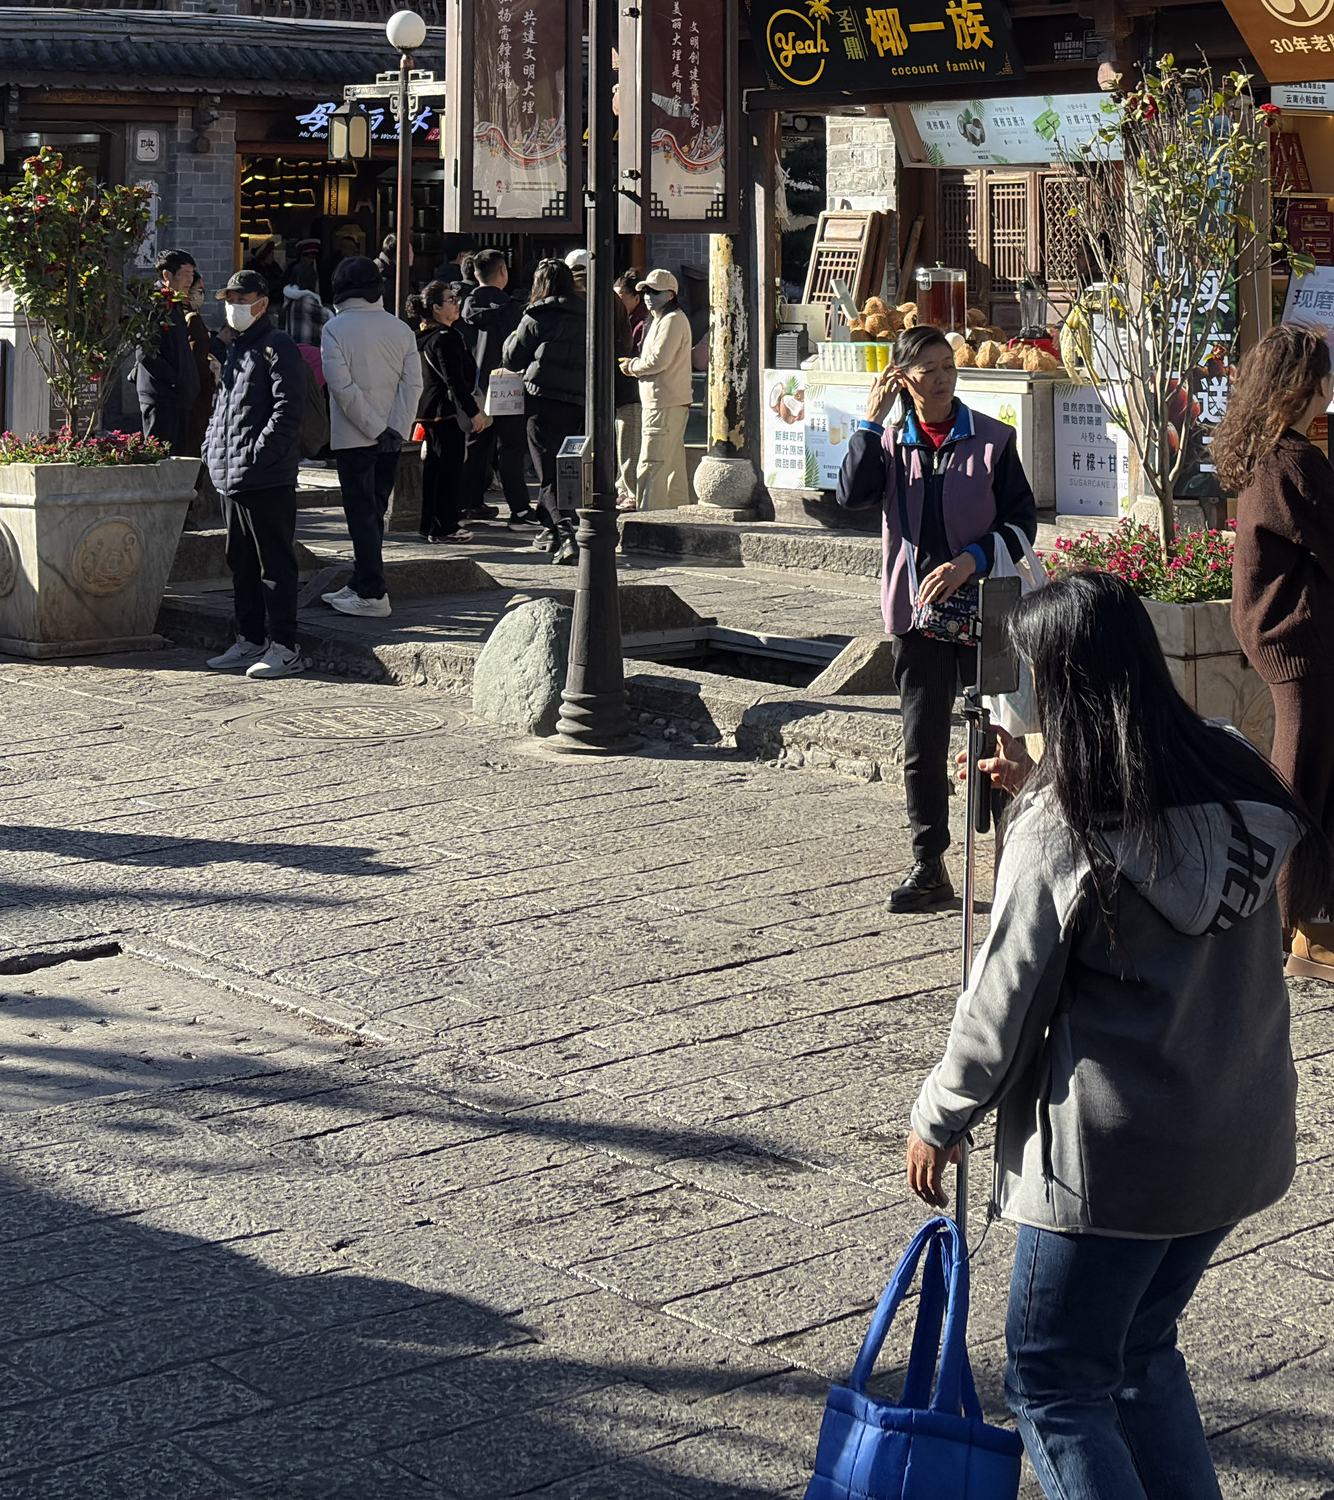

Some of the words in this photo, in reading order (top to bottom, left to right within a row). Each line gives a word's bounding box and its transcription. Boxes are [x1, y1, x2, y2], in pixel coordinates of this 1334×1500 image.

[835, 9, 863, 61] 圣鼎
[773, 20, 831, 68] Yeah
[521, 9, 538, 115] 共建文明大理
[891, 62, 940, 77] cocount
[946, 58, 986, 74] family
[1286, 94, 1326, 106] 云南小粒咖啡
[140, 137, 155, 153] 映
[1063, 402, 1102, 414] 自然的馈赠
[1063, 414, 1102, 426] 原始的味道
[774, 430, 804, 442] 新鲜现榨
[774, 444, 804, 456] 原汁原味
[1069, 478, 1110, 489] SUGARCANE
[1112, 481, 1128, 490] JUIC
